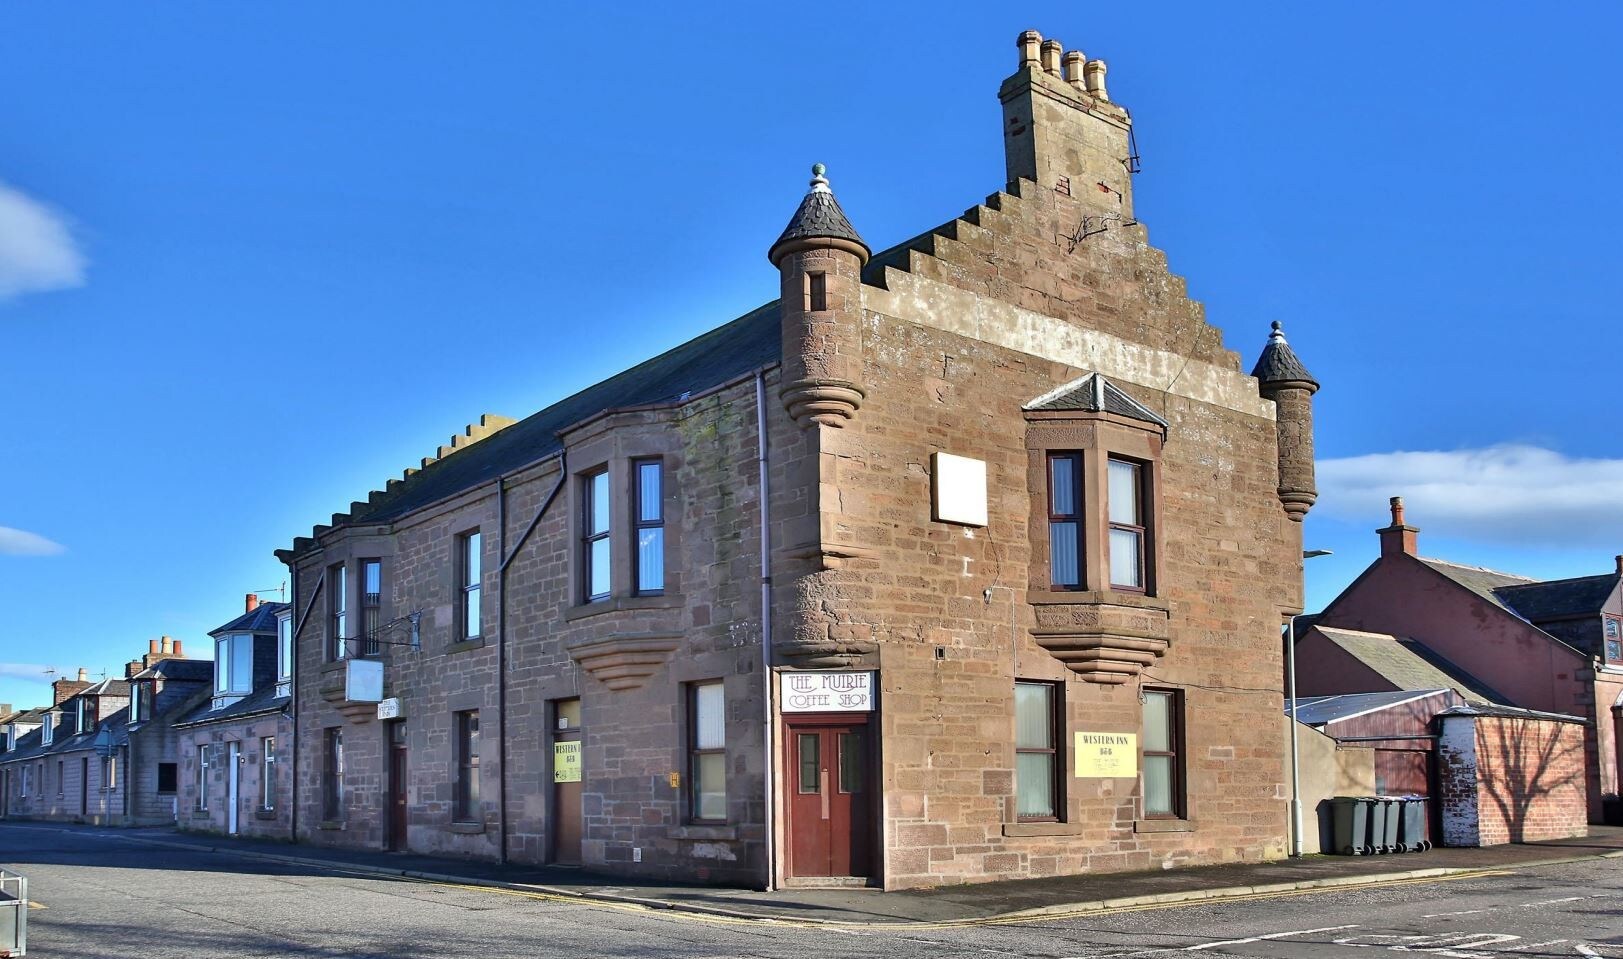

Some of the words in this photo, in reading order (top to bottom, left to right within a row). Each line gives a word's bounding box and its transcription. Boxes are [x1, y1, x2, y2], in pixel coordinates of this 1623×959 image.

[789, 676, 817, 693] THE
[822, 675, 867, 692] MUIRIE
[789, 694, 830, 709] COFFEE
[838, 694, 867, 708] SHOP
[1083, 735, 1115, 745] WESTERN
[1116, 736, 1128, 746] INN
[555, 745, 577, 754] WESTERN
